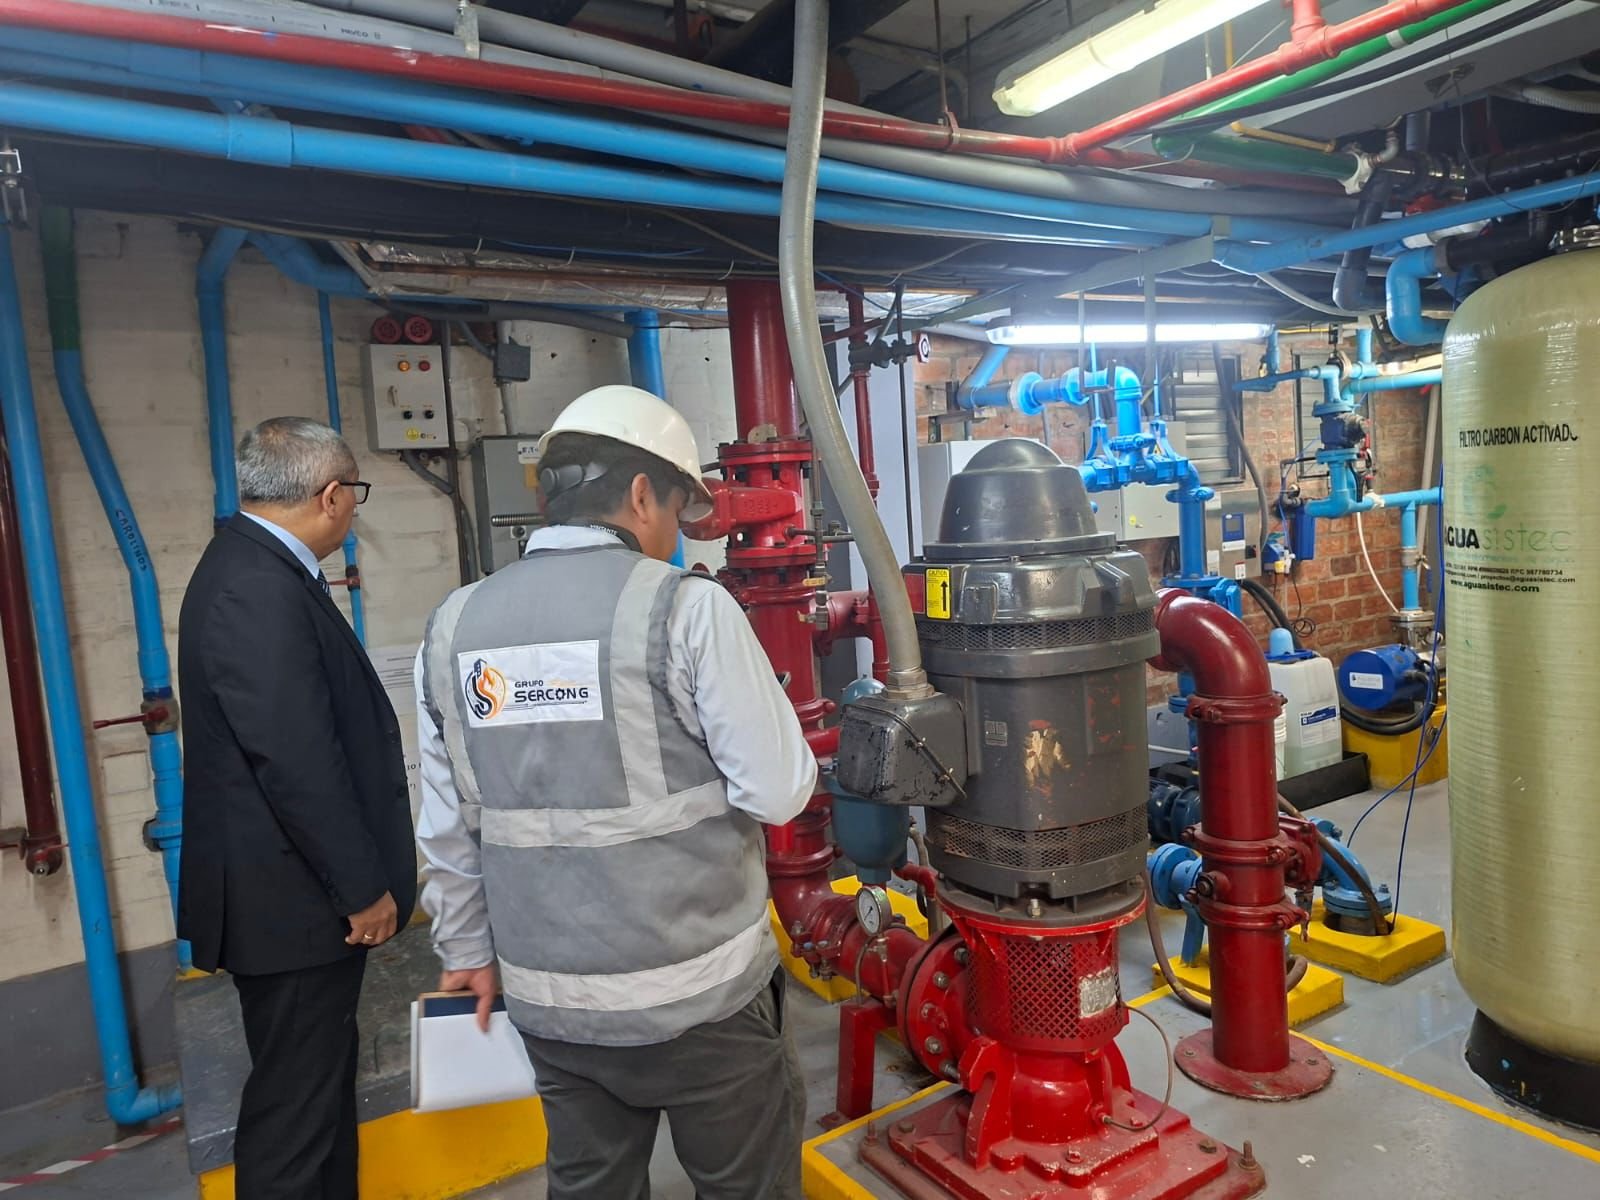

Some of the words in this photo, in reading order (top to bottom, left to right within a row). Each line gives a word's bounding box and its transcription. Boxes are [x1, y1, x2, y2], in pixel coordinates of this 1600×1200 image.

[1459, 429, 1481, 449] FILTRO
[1482, 425, 1520, 447] CARBON
[1450, 579, 1540, 593] www.aguasistec.com
[514, 679, 544, 688] GRUPO
[514, 687, 589, 703] SERCONG
